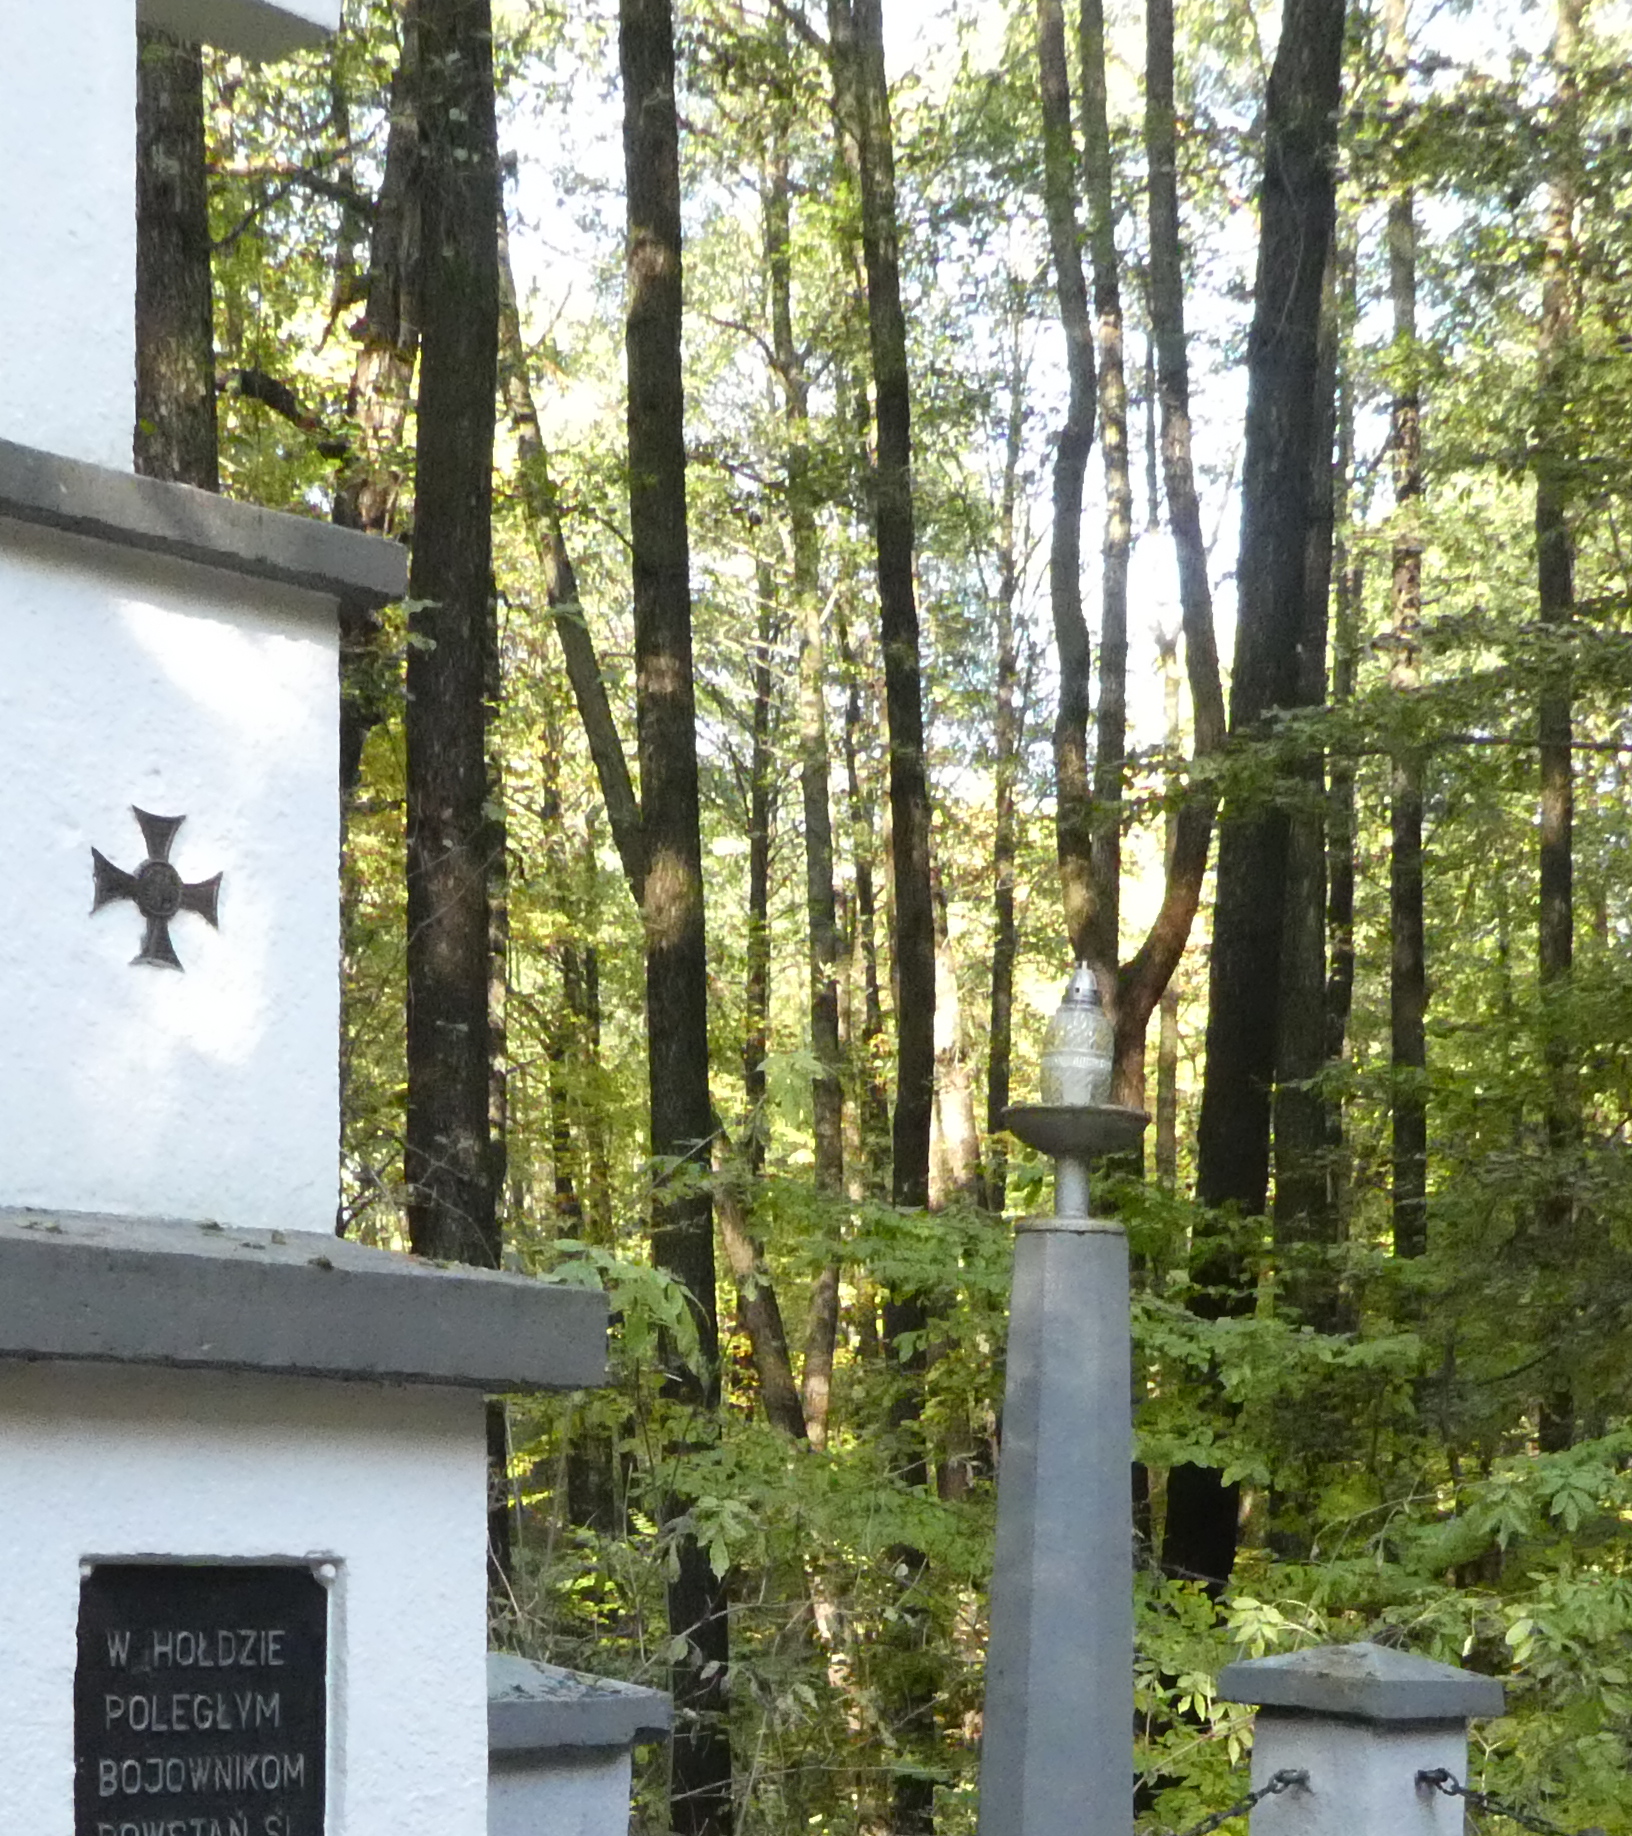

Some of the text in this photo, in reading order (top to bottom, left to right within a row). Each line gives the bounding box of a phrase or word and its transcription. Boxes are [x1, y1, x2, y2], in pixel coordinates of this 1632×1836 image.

[106, 1629, 286, 1667] W HOŁDZIE
[104, 1690, 281, 1732] POLEGŁYM
[98, 1752, 306, 1797] BOJOWNIKOM
